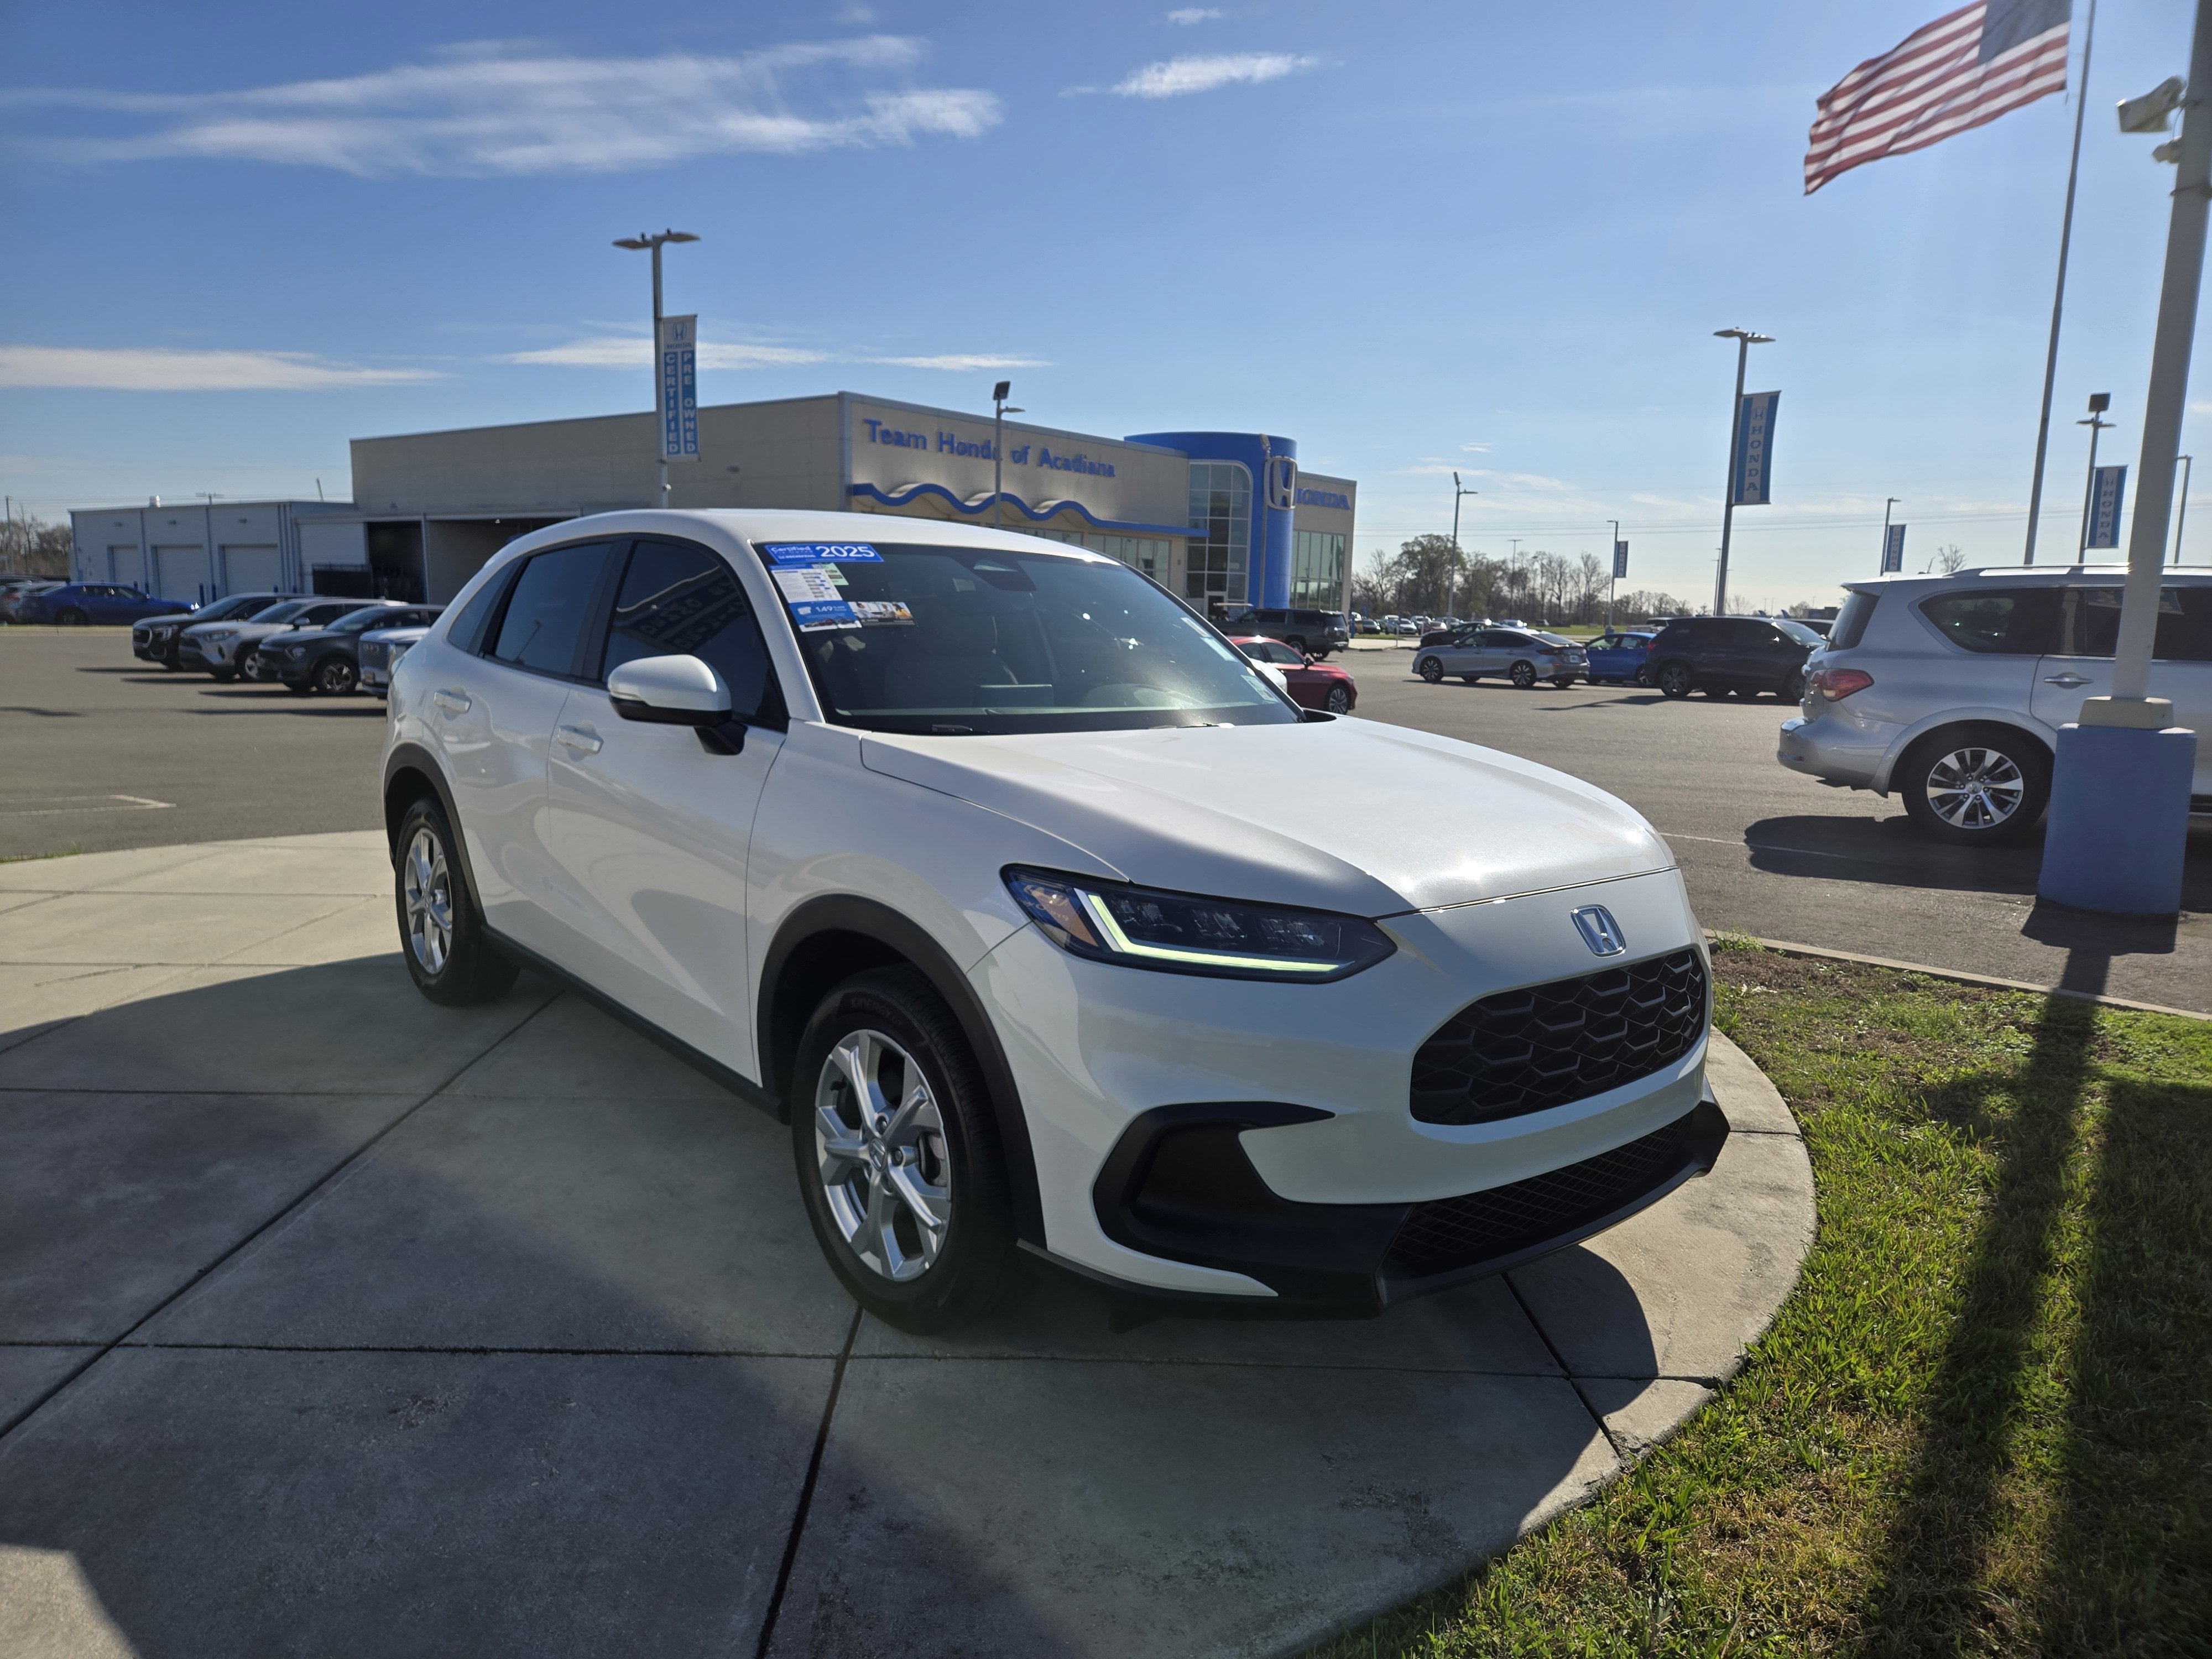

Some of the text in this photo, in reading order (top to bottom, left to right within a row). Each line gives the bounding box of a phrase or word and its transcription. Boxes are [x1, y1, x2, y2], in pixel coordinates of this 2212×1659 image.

[665, 354, 679, 453] CERTIFIED
[684, 353, 696, 452] PRE OWNED
[864, 419, 927, 450] Team
[1011, 445, 1031, 465] of
[1038, 448, 1115, 478] Acadiana
[1745, 425, 1764, 492] HONDA
[815, 545, 875, 558] 2025
